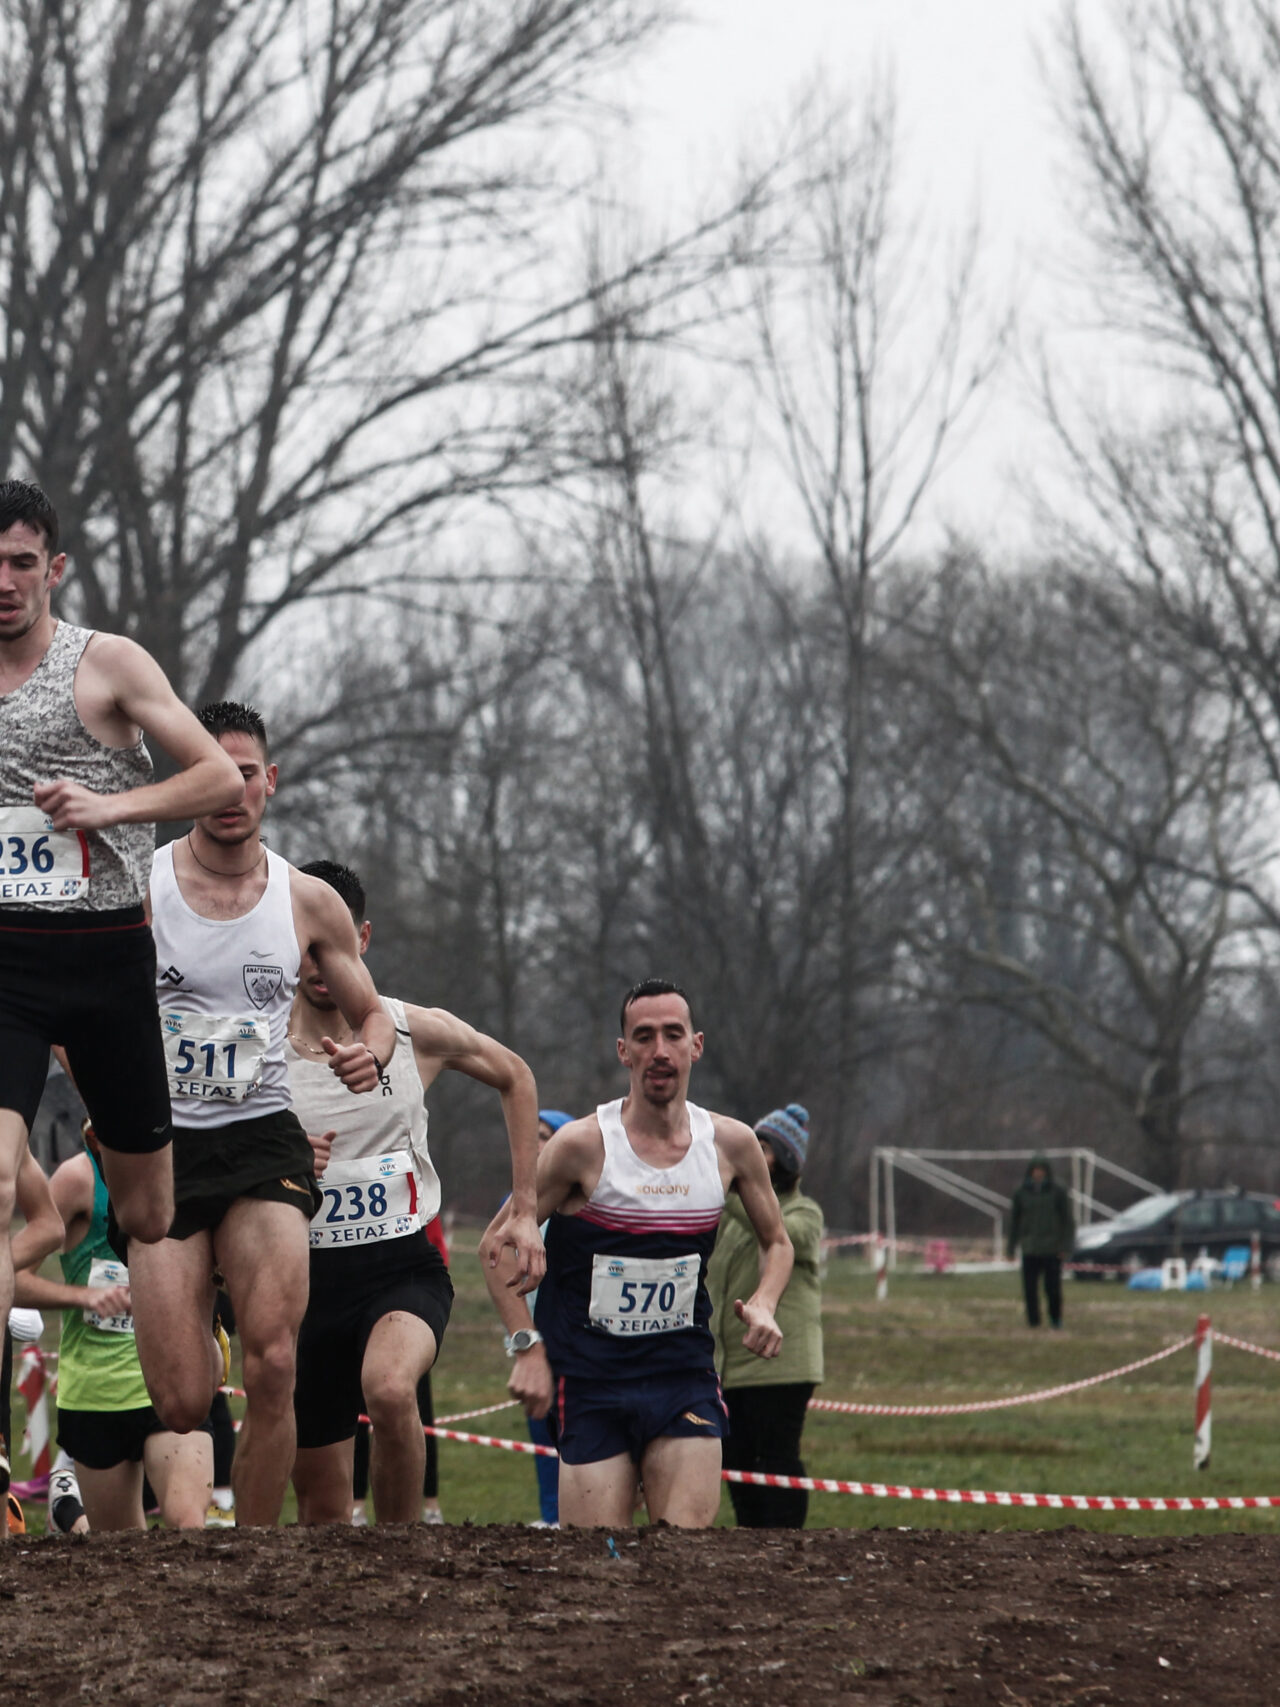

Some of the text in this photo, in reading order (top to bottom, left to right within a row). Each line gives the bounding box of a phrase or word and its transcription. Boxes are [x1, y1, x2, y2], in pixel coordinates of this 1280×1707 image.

[239, 1027, 256, 1035] ΑΥΡΑ
[174, 1039, 237, 1079] 511
[176, 1081, 237, 1099] ΣΕΓΑΣ
[378, 1163, 396, 1172] ΑΥΡΑ
[635, 1183, 690, 1196] saucony
[323, 1182, 388, 1223] 238
[331, 1223, 389, 1243] ΣΕΓΑΣ
[618, 1281, 676, 1314] 570
[620, 1317, 671, 1332] ΣΕΓΑΣ
